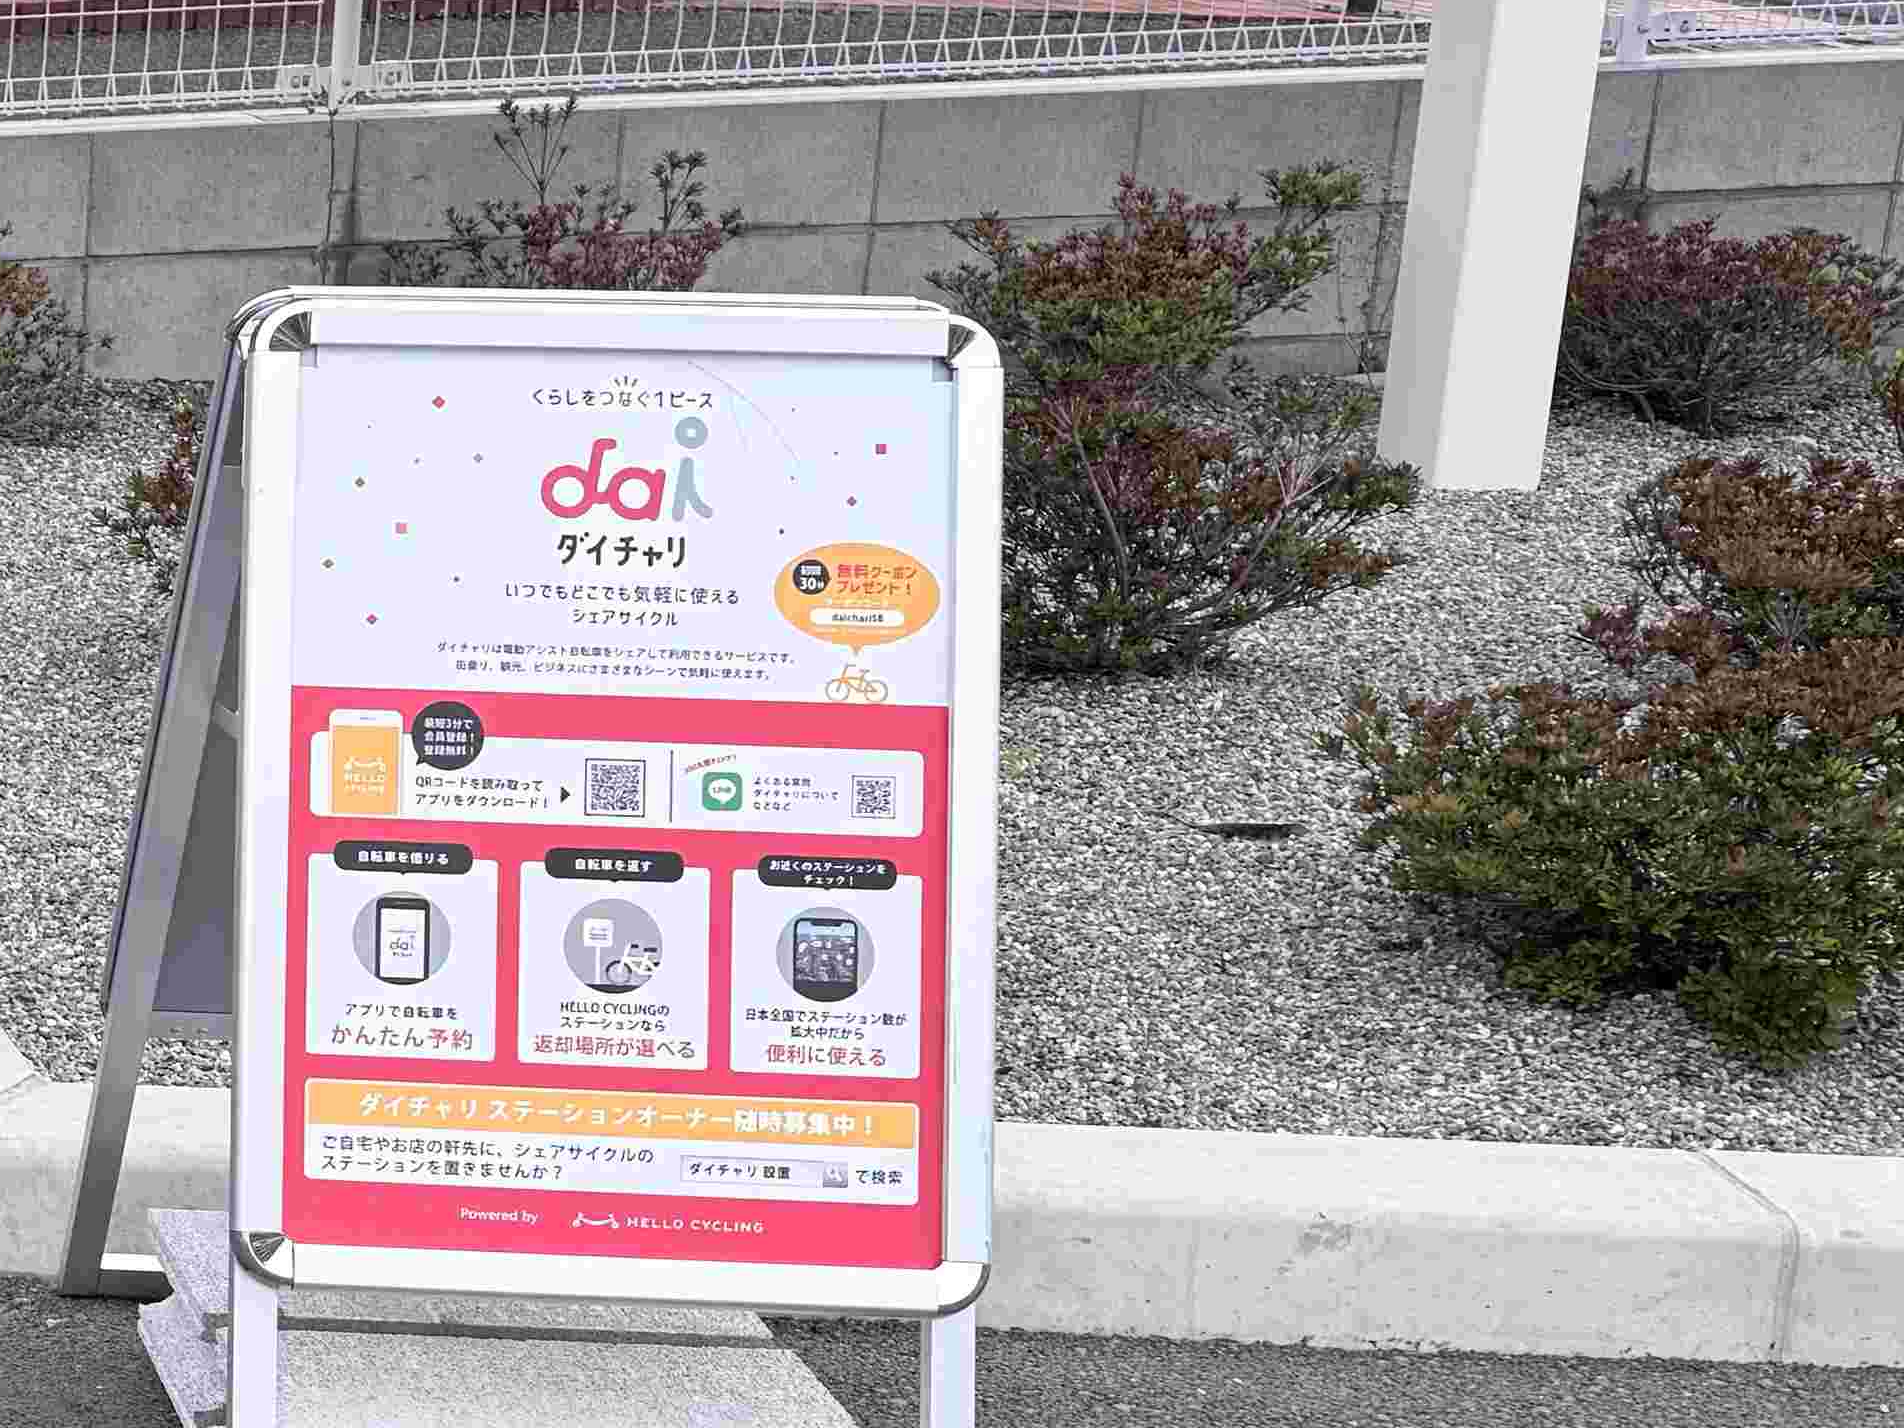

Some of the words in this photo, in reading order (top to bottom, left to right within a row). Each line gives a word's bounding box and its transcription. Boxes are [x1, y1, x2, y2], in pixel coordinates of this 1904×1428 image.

[532, 388, 713, 409] くらしをつなぐ1ピース
[541, 416, 713, 522] dai
[557, 531, 686, 568] ダイチャリ
[505, 583, 739, 605] いつでもどこでも気軽に使える
[573, 609, 679, 627] シェアサイクル
[415, 775, 544, 792] QRコードを読み取って
[415, 793, 549, 809] アプリをダウンロード！
[357, 850, 449, 865] 自転車を借りる
[769, 859, 888, 875] お近くのステーションを
[803, 874, 855, 886] チェック！
[345, 1003, 458, 1020] アプリで自転車を
[560, 1002, 599, 1014] HELLO
[745, 1008, 907, 1026] 日本全国でステーション数が
[560, 1017, 665, 1032] ステーションなら
[791, 1025, 865, 1040] 拡大中だから
[331, 1024, 473, 1051] かんたん予約
[534, 1034, 696, 1059] 返却場所が選べる
[766, 1043, 887, 1067] 便利に使える
[360, 1092, 478, 1119] ダイチャリ
[321, 1133, 655, 1164] ご自宅やお店の軒先に、シェアサイクルの
[321, 1155, 563, 1180] ステーションを置きませんか？
[689, 1162, 757, 1178] ダイチャリ
[762, 1165, 791, 1180] 設置
[855, 1168, 904, 1185] で検索
[459, 1207, 518, 1222] Powered
[522, 1209, 539, 1225] by
[625, 1217, 685, 1230] HELLO
[690, 1219, 765, 1234] CYCLING
